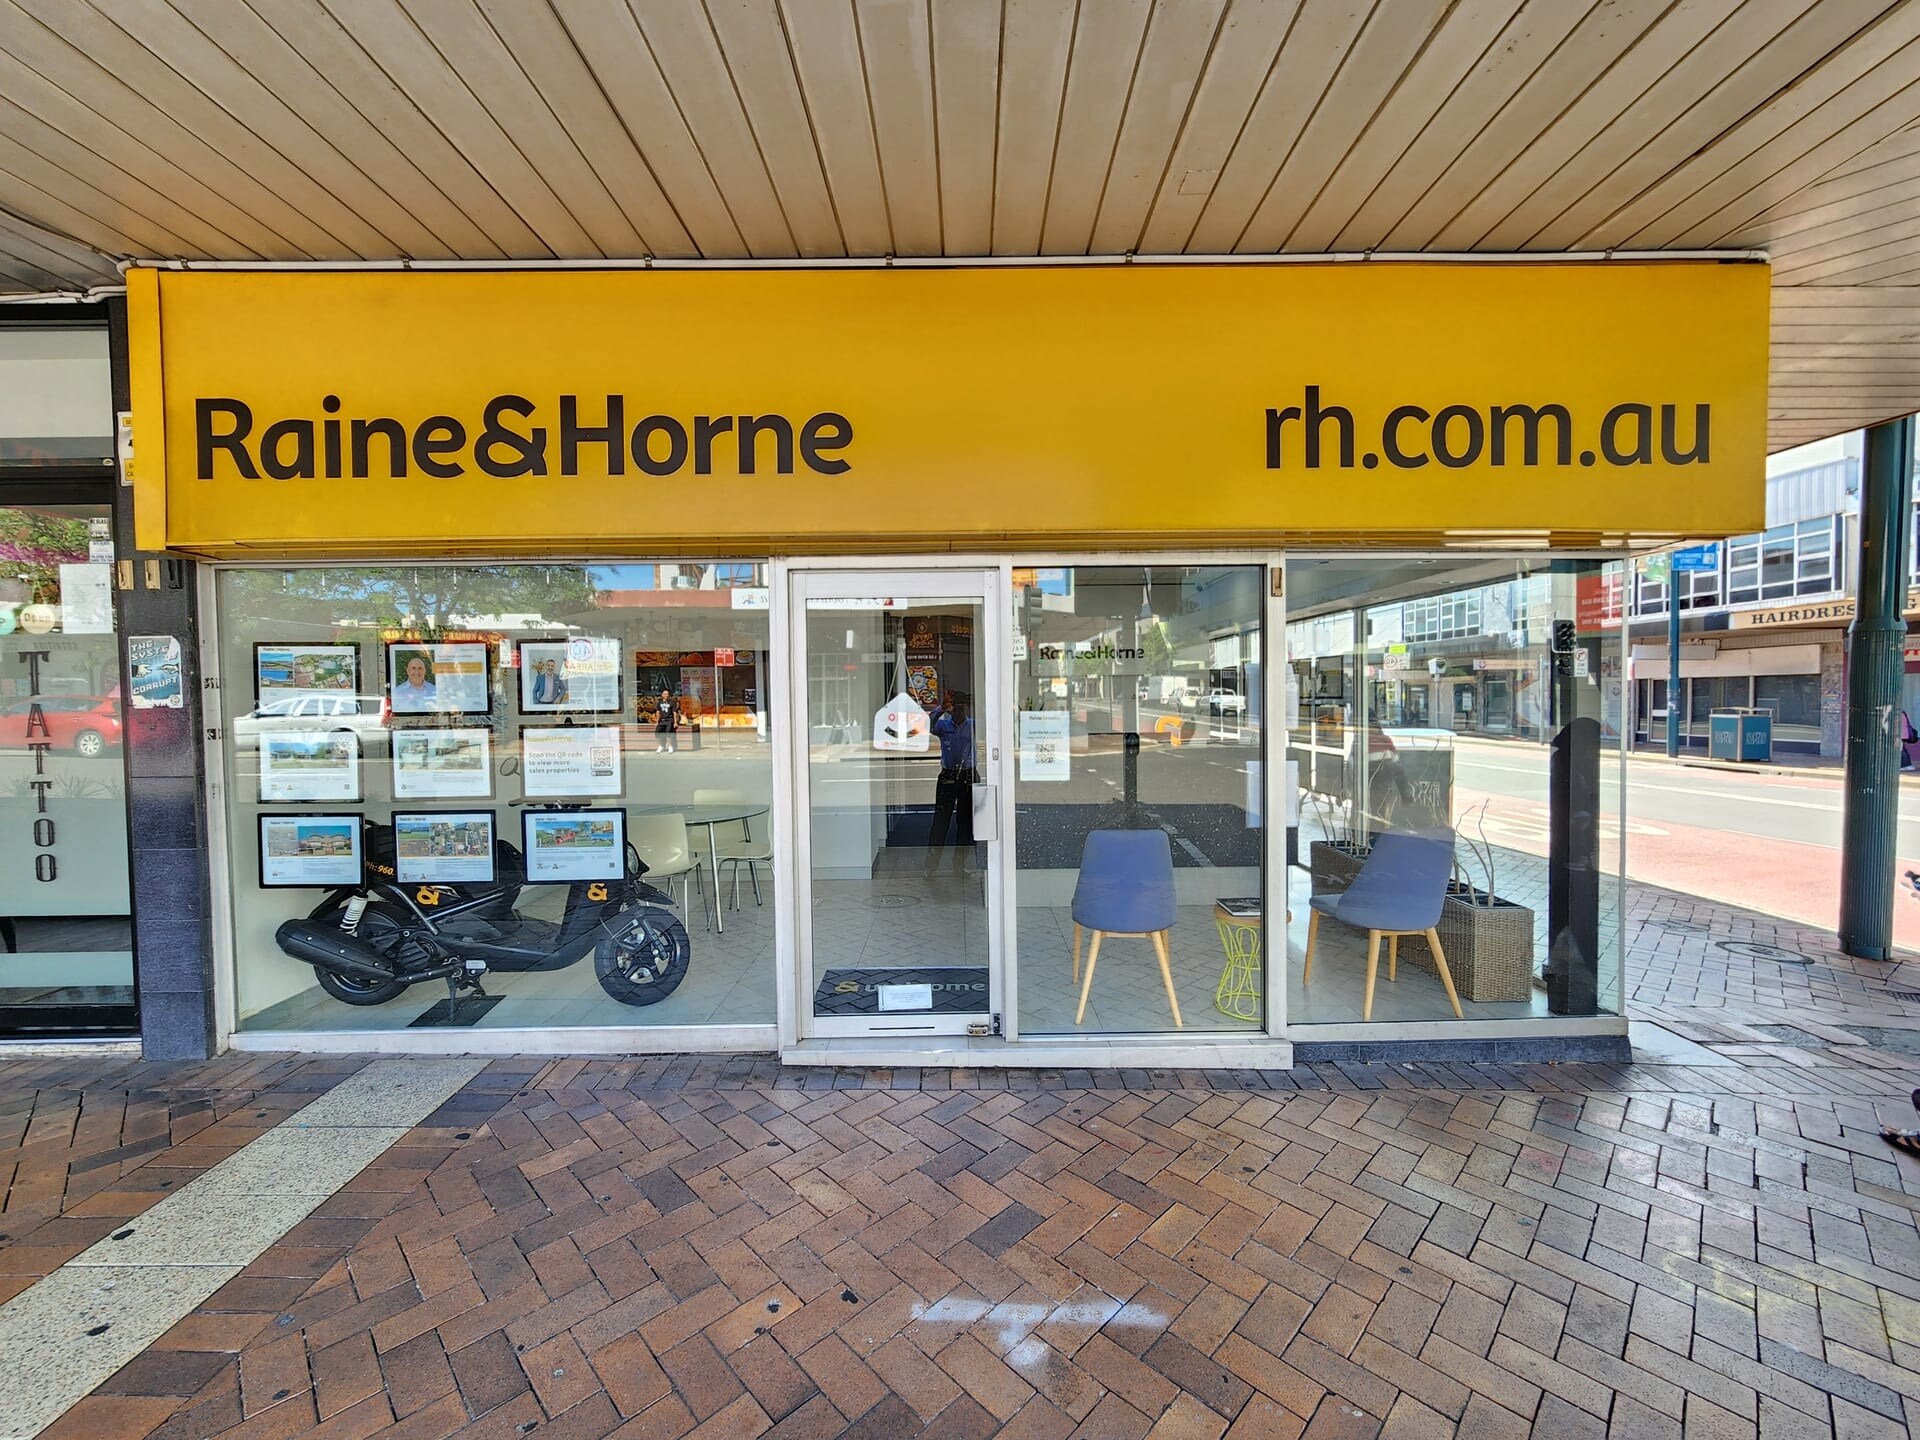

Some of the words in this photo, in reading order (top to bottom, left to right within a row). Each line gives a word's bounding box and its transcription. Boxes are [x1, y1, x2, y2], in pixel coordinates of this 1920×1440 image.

[1265, 385, 1710, 469] rh.com.au
[195, 394, 854, 481] Raine&Horne
[131, 640, 153, 651] THE
[1040, 645, 1145, 660] Rane&Horne
[133, 676, 178, 695] CORRUPT
[557, 751, 567, 759] QR
[18, 651, 57, 883] TATTOO
[377, 864, 395, 876] 960
